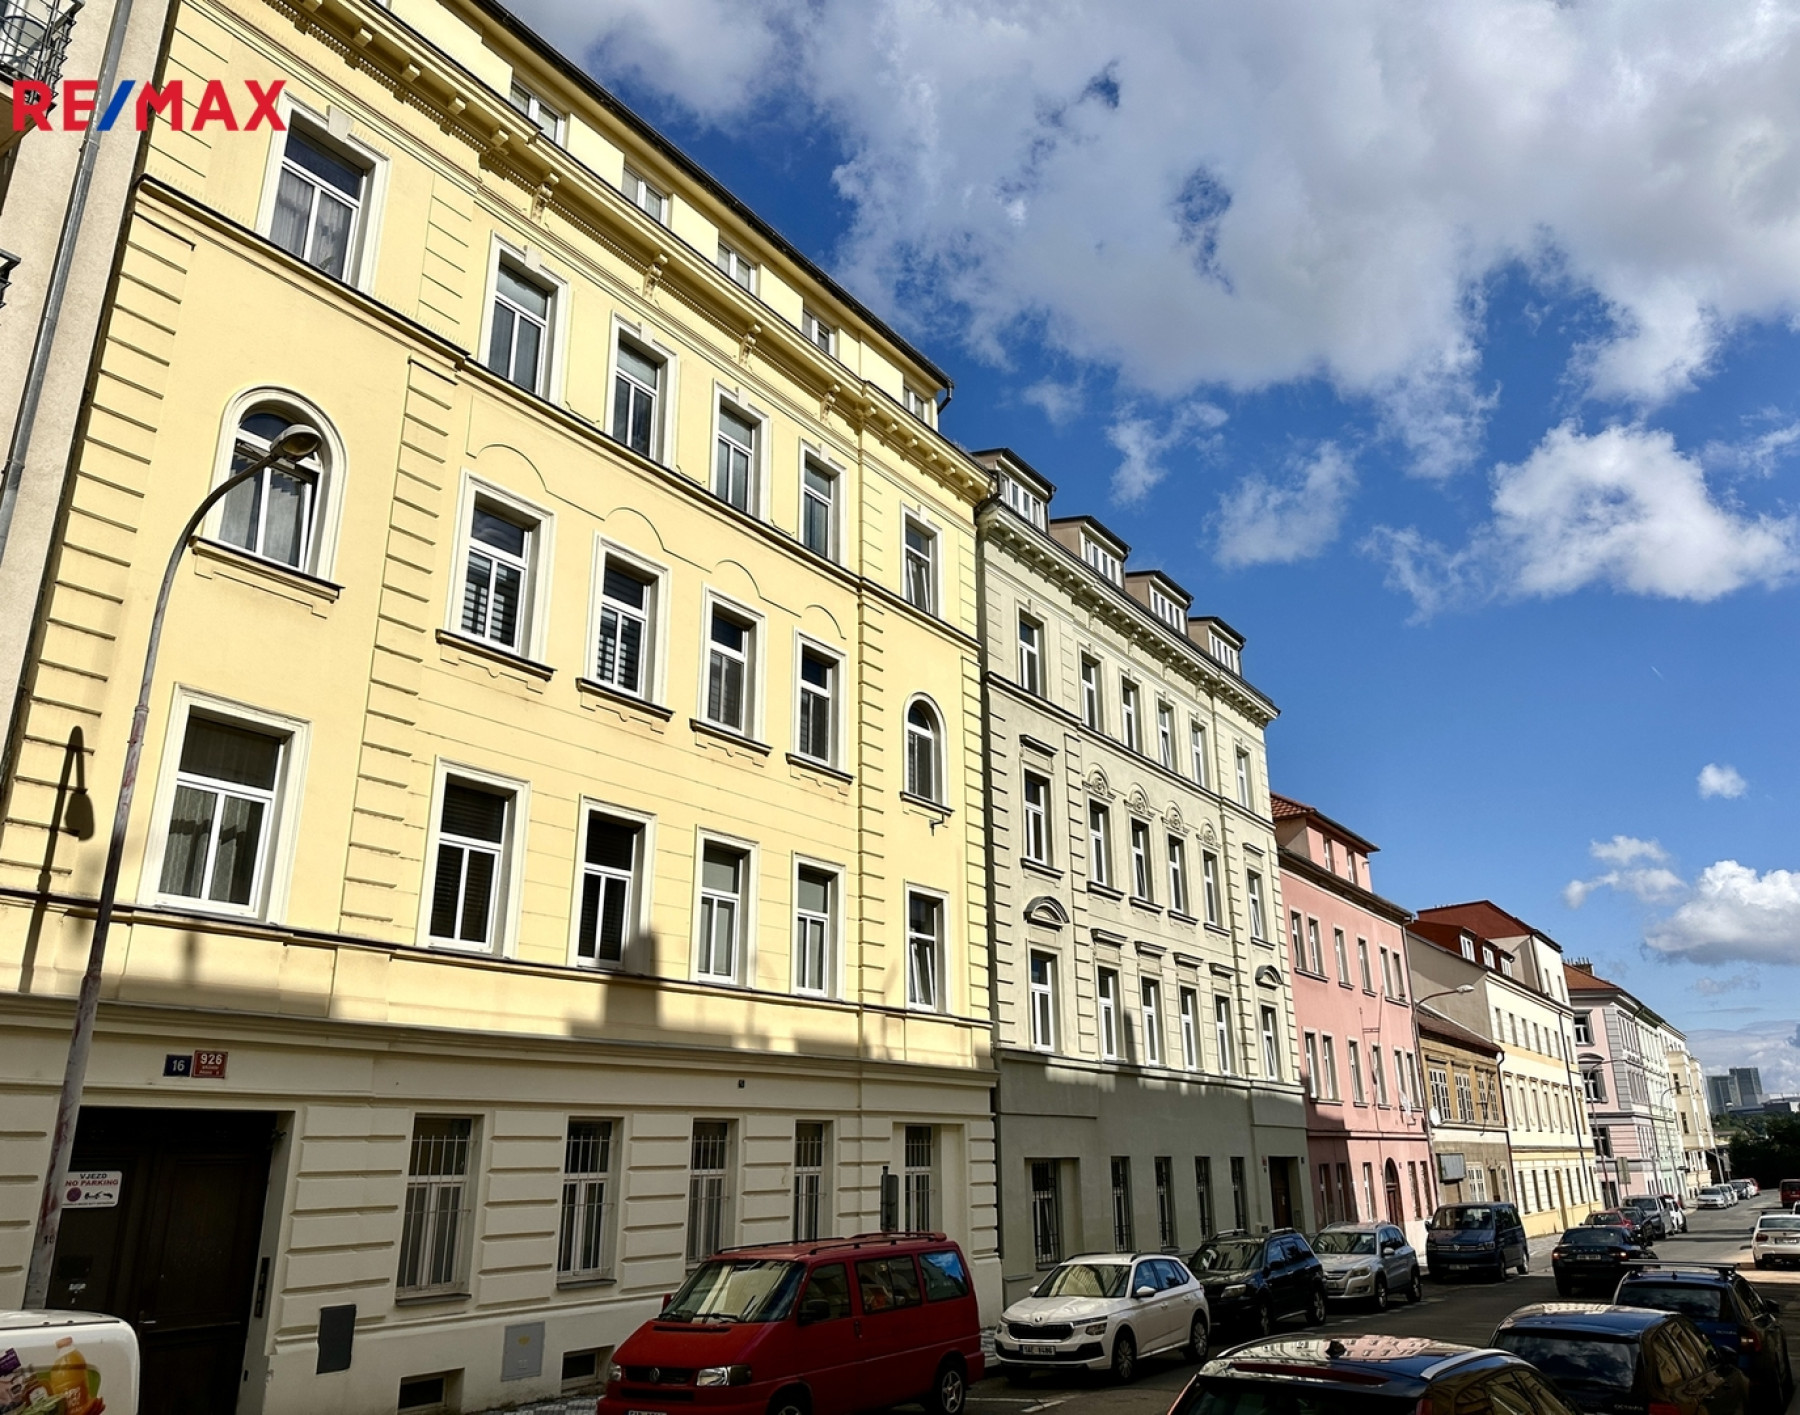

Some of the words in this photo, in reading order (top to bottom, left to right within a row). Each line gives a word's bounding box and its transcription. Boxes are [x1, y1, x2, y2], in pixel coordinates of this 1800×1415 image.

[200, 1053, 223, 1065] 926
[172, 1059, 185, 1072] 16
[80, 1179, 119, 1187] PARKING
